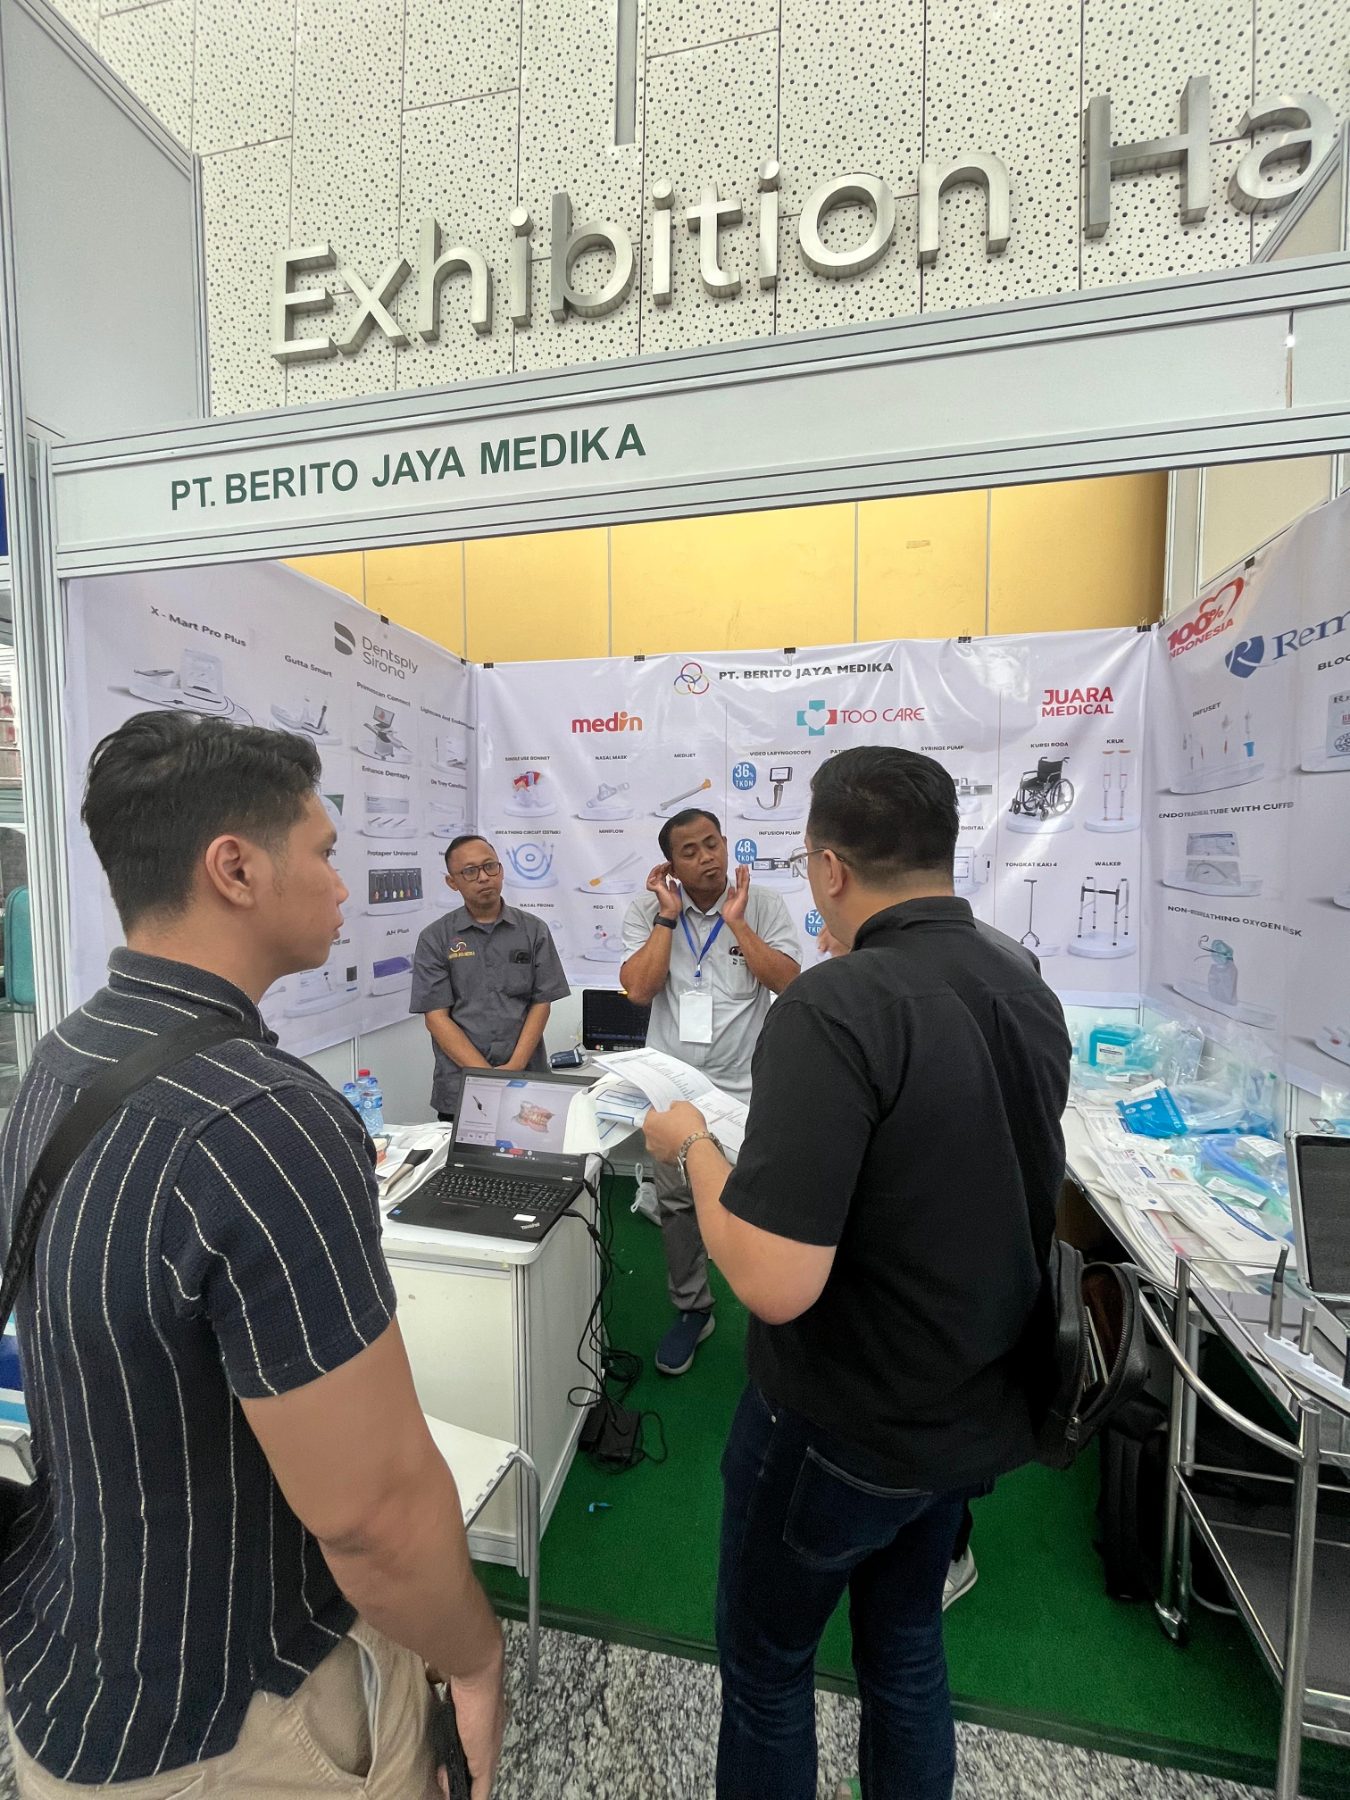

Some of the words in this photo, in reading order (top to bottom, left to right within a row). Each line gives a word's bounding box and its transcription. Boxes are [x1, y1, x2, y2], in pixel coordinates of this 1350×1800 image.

[272, 151, 1011, 363] Exhibition
[171, 477, 217, 511] PT.
[224, 458, 359, 505] BERITO
[371, 446, 466, 488] JAYA
[479, 422, 647, 475] MEDIKA
[150, 605, 160, 616] X
[168, 613, 199, 631] Mart
[201, 625, 222, 639] Pro
[224, 633, 247, 647] Plus
[1166, 603, 1225, 651] 100%
[1168, 617, 1235, 662] NDONESIA
[284, 654, 309, 669] Gutta
[310, 663, 333, 678] Smart
[362, 636, 419, 674] Dentsply
[362, 651, 405, 680] Sirona
[718, 671, 740, 681] PT.
[743, 669, 792, 680] BERITO
[796, 666, 834, 679] JAYA
[836, 662, 894, 674] MEDIKA
[1041, 686, 1114, 705] JUARA
[571, 711, 643, 733] medin
[839, 710, 877, 724] TOO
[882, 707, 926, 721] CARE
[1041, 703, 1114, 718] MEDICAL
[385, 769, 411, 780] Dentsply
[1230, 804, 1261, 813] WITH
[1241, 917, 1282, 931] OXYGEN
